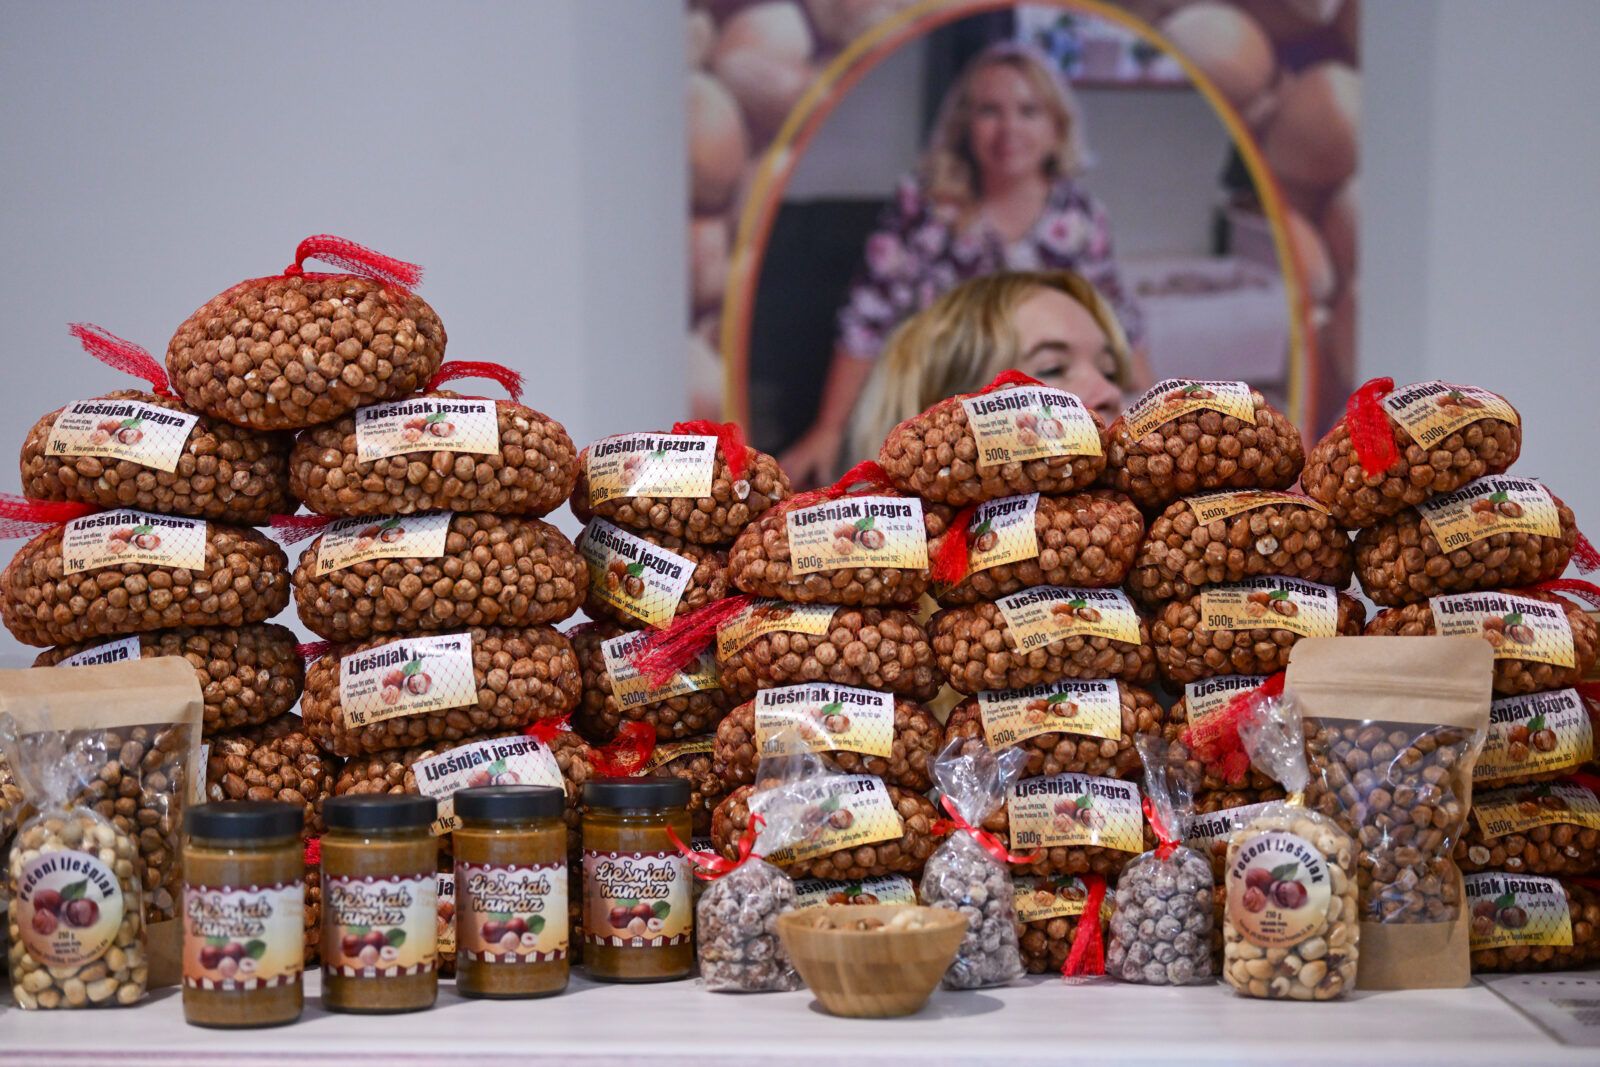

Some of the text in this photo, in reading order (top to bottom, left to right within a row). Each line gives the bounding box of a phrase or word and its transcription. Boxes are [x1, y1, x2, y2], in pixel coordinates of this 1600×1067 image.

[972, 392, 1078, 416] Lješnjak jezgra
[1388, 382, 1448, 410] Lješnjak
[72, 403, 186, 428] Lješnjak jezgra
[366, 402, 486, 420] Lješnjak jezgra
[1137, 420, 1160, 436] 500g
[1420, 425, 1448, 444] 500g
[52, 440, 67, 453] 1kg
[594, 438, 706, 458] Lješnjak jezgra
[985, 448, 1010, 461] 500g
[1491, 479, 1537, 492] jezgra
[794, 502, 912, 526] Lješnjak jezgra
[984, 500, 1028, 522] jezgra
[1202, 507, 1228, 520] 500g
[74, 514, 195, 530] Lješnjak jezgra
[1444, 532, 1472, 548] 500g
[590, 524, 682, 580] Lješnjak jezgra
[69, 559, 85, 570] 1kg
[321, 559, 334, 570] 1kg
[798, 556, 823, 569] 500g
[1279, 578, 1327, 598] jezgra
[1005, 588, 1118, 610] Lješnjak jezgra
[1440, 598, 1556, 618] Lješnjak jezgra
[1208, 614, 1234, 628] 500g
[722, 638, 738, 654] 500g
[1022, 632, 1048, 648] 500g
[348, 646, 409, 675] Lješnjak
[764, 688, 882, 706] Lješnjak jezgra
[1058, 682, 1108, 694] jezgra
[1194, 678, 1260, 698] Lješnjak
[621, 691, 647, 706] 500g
[350, 710, 366, 724] 1kg
[1490, 696, 1575, 724] šnjak jezgra
[993, 730, 1016, 746] 500g
[424, 740, 540, 782] Lješnjak jezgra
[1016, 779, 1130, 800] Lješnjak jezgra
[438, 816, 455, 830] 1kg
[1488, 820, 1514, 834] 500g
[1016, 832, 1042, 845] 500g
[1233, 839, 1270, 880] Pečeni
[595, 861, 676, 886] Lješnjak
[468, 874, 551, 900] Lješnjak
[601, 884, 669, 898] namaz
[796, 878, 849, 896] ešnjak
[1466, 878, 1553, 897] njak jezgra
[473, 897, 544, 913] namaz
